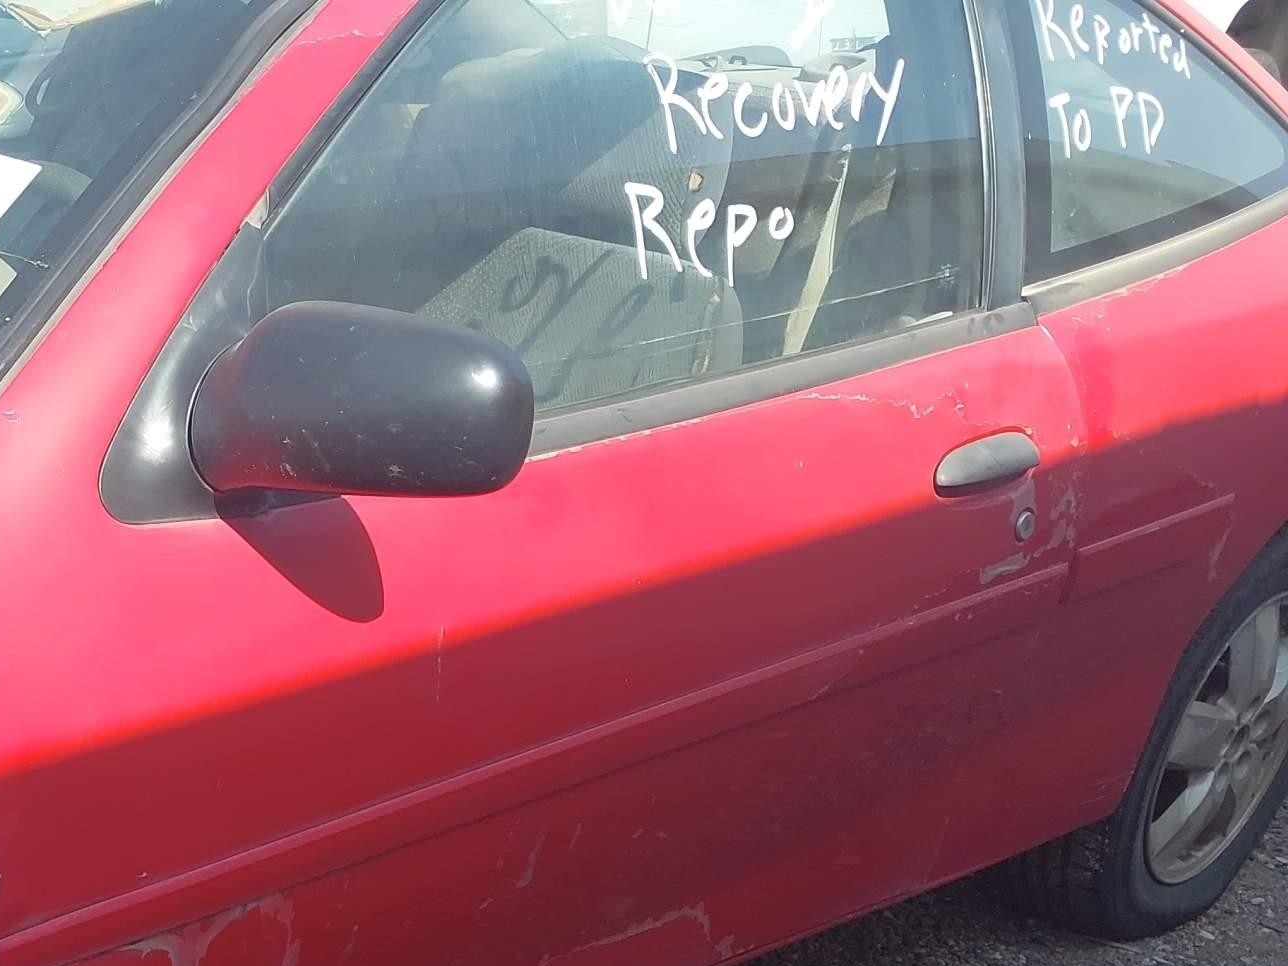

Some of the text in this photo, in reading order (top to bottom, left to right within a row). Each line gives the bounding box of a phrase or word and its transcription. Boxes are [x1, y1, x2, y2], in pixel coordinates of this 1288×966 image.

[1036, 0, 1191, 80] Reported
[643, 51, 904, 154] Recovery
[1049, 85, 1165, 160] To PD
[624, 182, 795, 288] Repo
